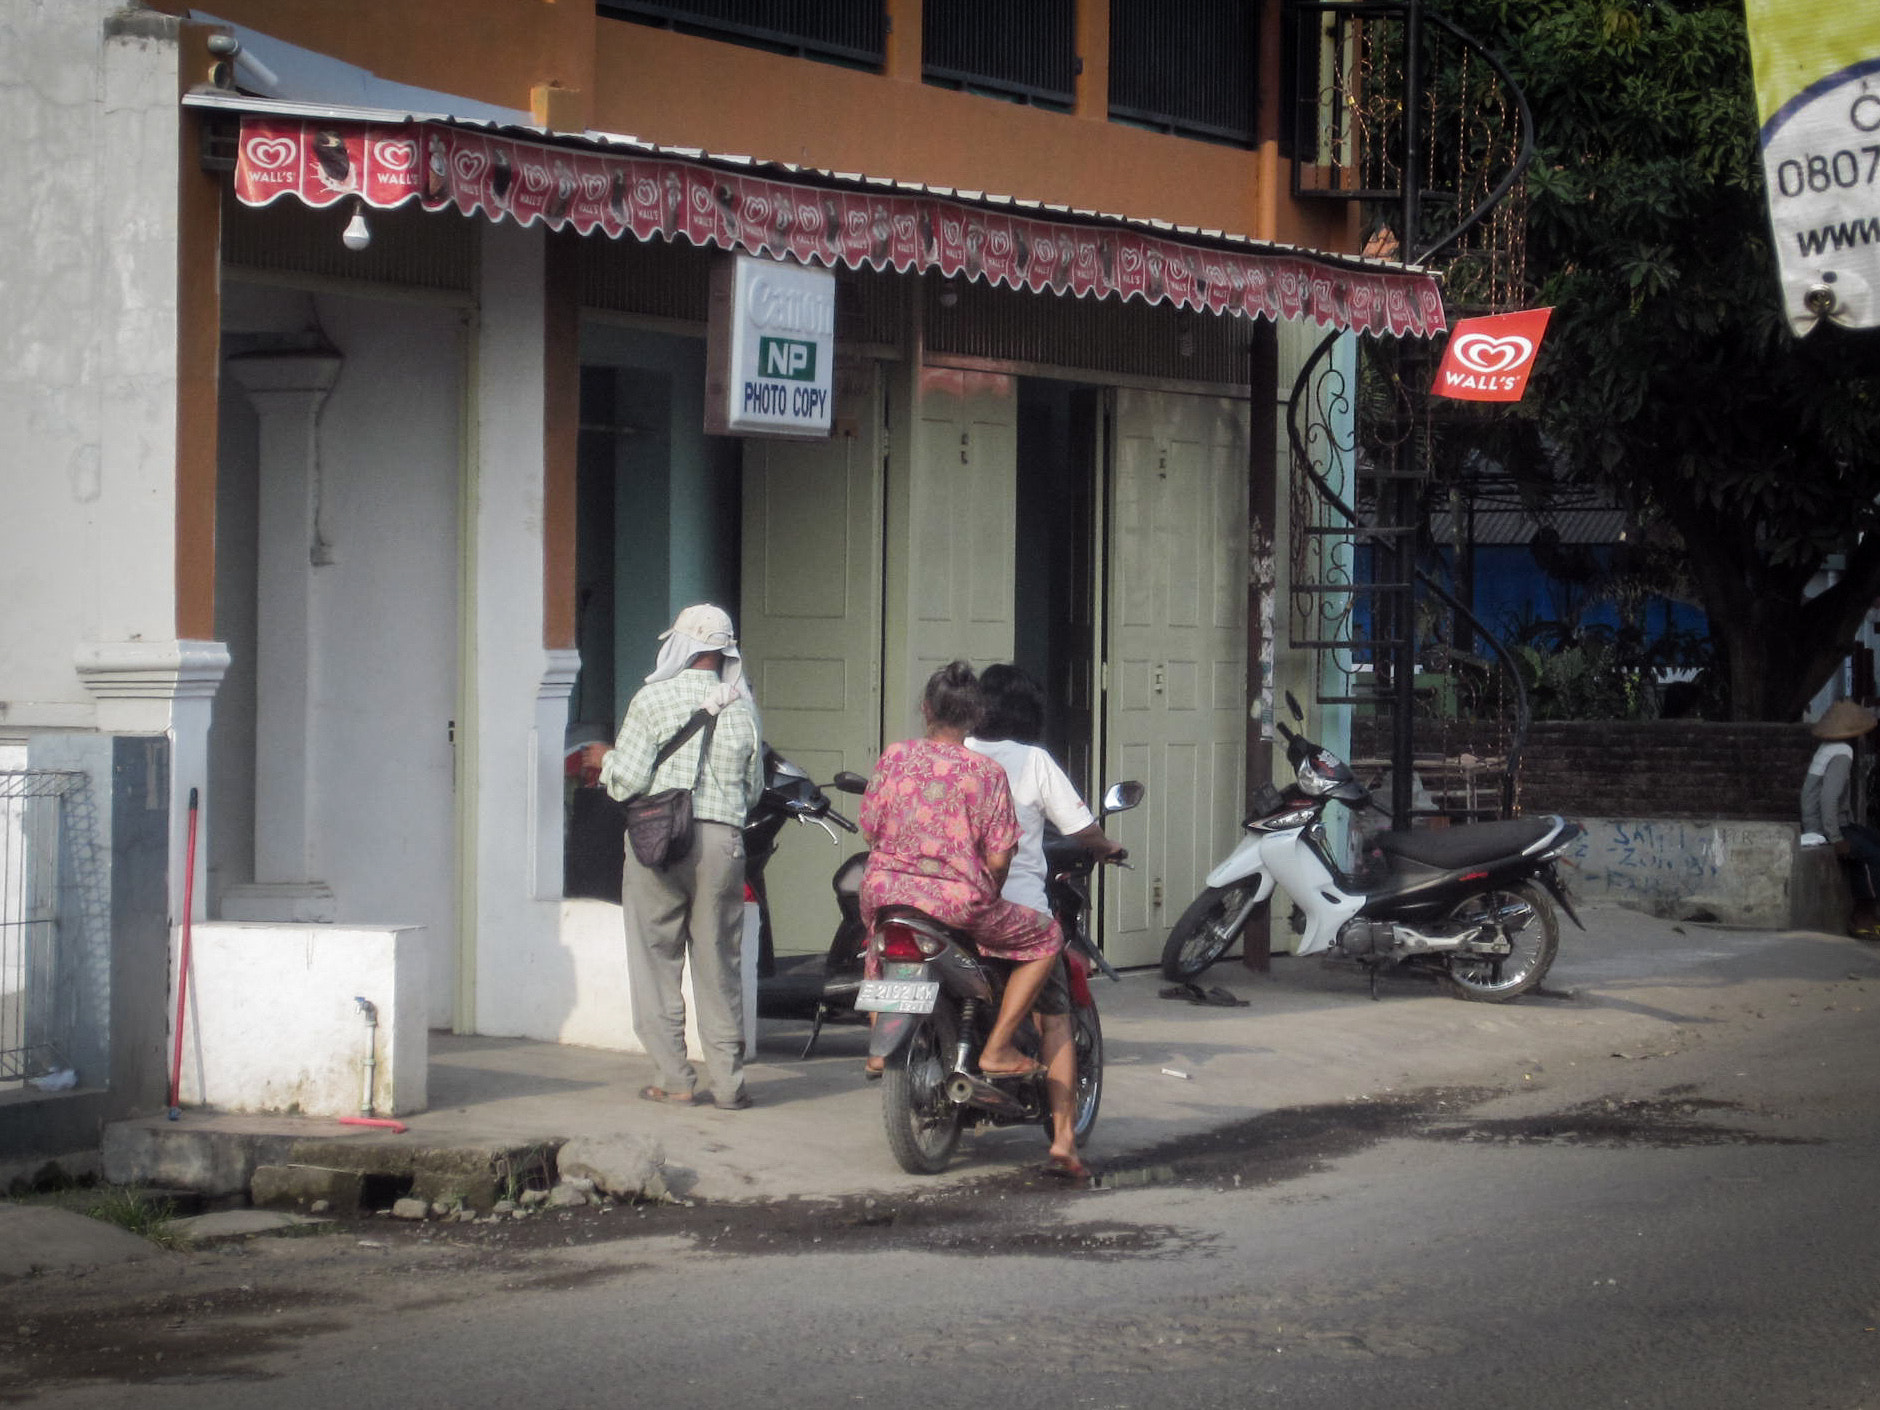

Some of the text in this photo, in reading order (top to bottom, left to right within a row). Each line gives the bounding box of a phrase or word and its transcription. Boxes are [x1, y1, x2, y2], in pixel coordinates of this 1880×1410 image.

[250, 171, 294, 183] WALL'S
[377, 172, 419, 185] WALL'S
[1778, 145, 1880, 198] 0807
[767, 341, 808, 377] NP
[1446, 371, 1516, 391] WALL'S
[744, 382, 827, 419] PHOTO COPY
